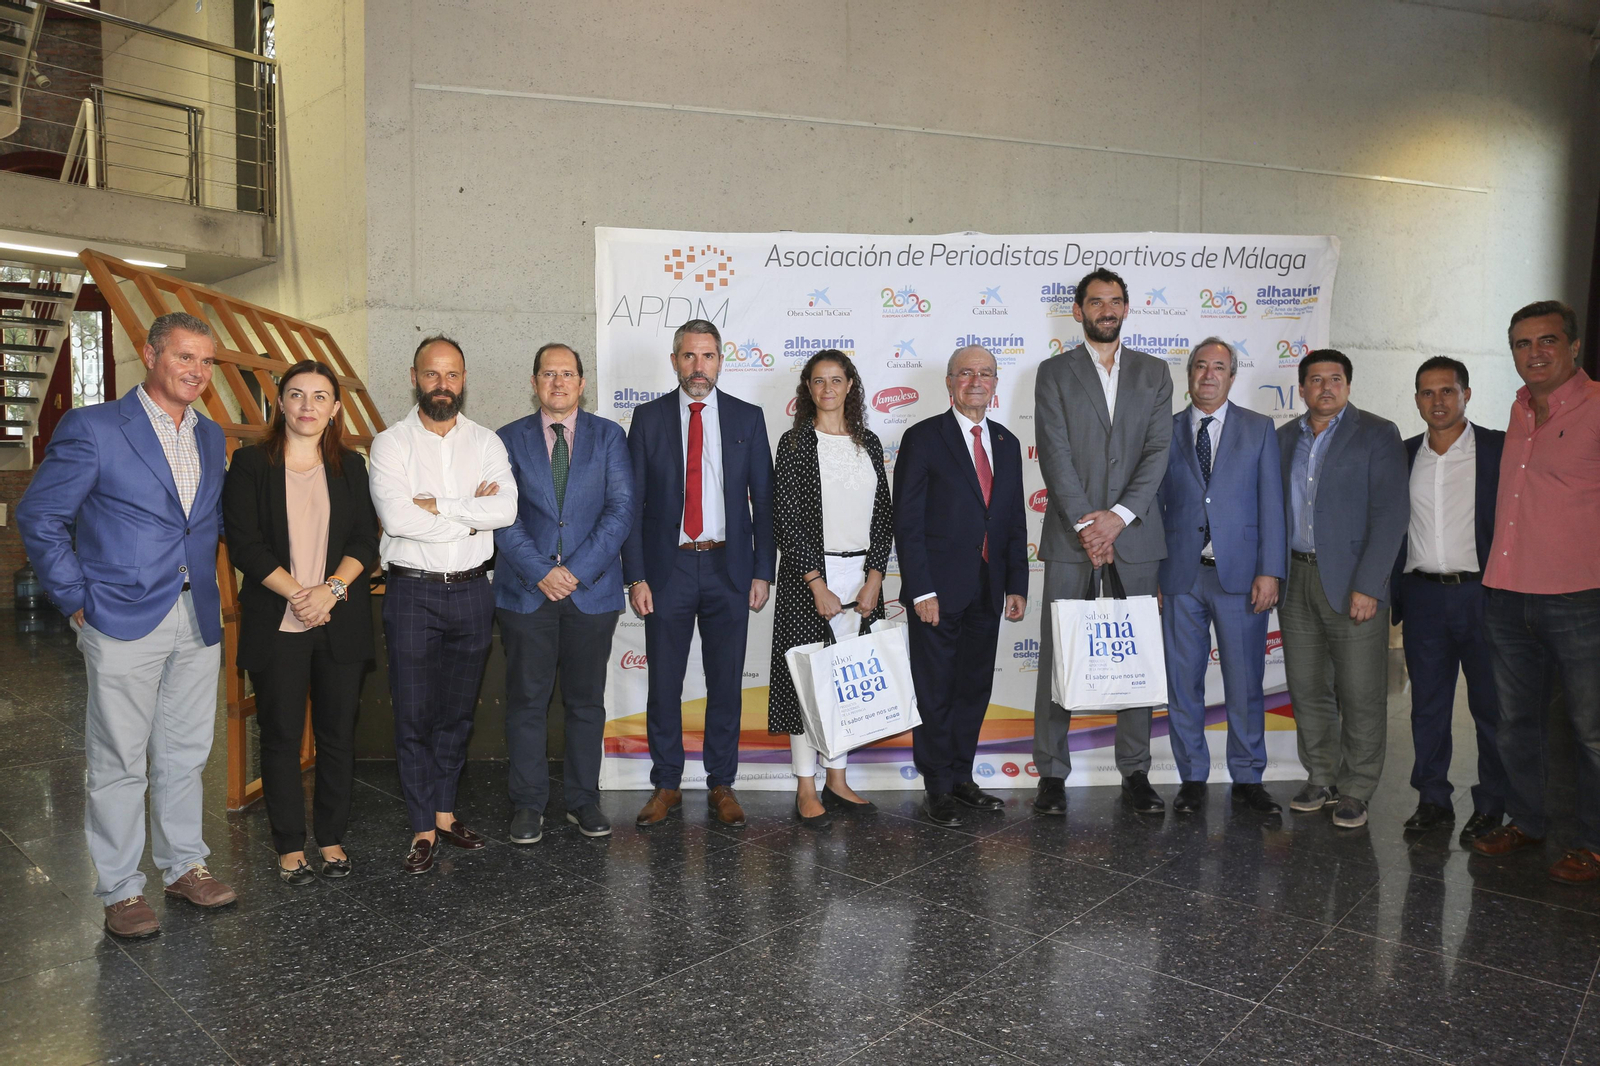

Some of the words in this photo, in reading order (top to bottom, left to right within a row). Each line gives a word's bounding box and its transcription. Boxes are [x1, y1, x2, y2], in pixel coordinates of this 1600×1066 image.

[764, 243, 892, 268] Asociación
[896, 243, 925, 267] de
[929, 241, 1059, 267] Periodistas
[1063, 243, 1186, 271] Deportivos
[1190, 245, 1218, 269] de
[1223, 245, 1307, 276] Málaga
[1256, 283, 1320, 297] alhaurín
[606, 294, 730, 329] APDM
[787, 309, 804, 317] Obra
[804, 309, 823, 317] Social
[972, 307, 1009, 316] CaixaBank
[784, 335, 855, 349] alhaurín
[955, 333, 1024, 347] alhaurín
[1122, 333, 1189, 347] alhaurín
[886, 360, 923, 369] CaixaBank
[873, 388, 917, 409] famadesa
[1085, 611, 1110, 620] sabor
[1086, 622, 1093, 631] a
[1094, 613, 1136, 639] má
[1088, 633, 1138, 663] laga
[831, 654, 853, 667] sabor
[832, 668, 838, 678] a
[839, 648, 885, 683] má
[834, 675, 889, 703] laga
[840, 719, 847, 727] El
[847, 715, 864, 726] sabor
[865, 712, 876, 721] que
[876, 708, 887, 716] nos
[887, 705, 899, 713] une
